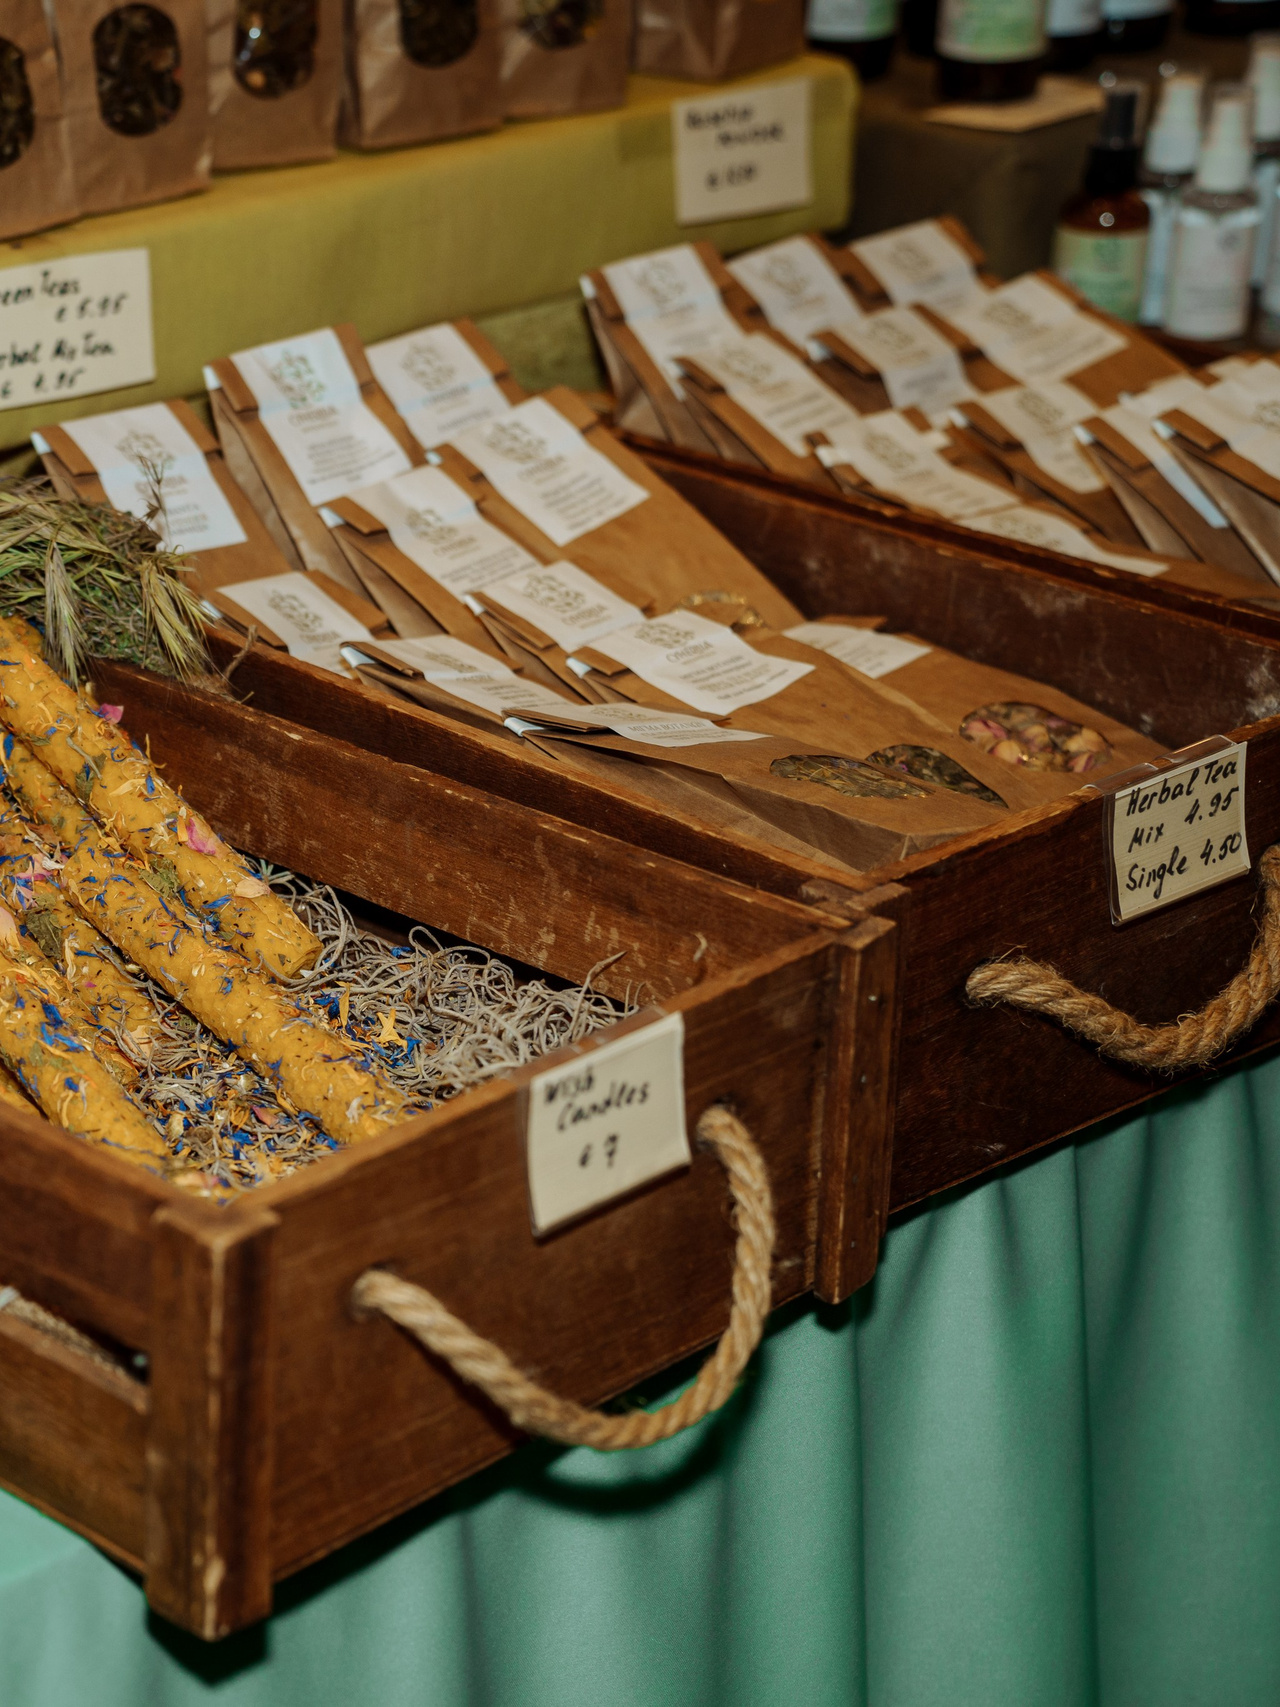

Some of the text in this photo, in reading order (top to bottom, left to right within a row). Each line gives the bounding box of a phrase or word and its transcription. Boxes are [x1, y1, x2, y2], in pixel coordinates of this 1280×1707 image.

[1126, 760, 1237, 817] Herbal Tea
[1184, 786, 1239, 825] 4.95
[1128, 823, 1164, 853] Mix
[1126, 831, 1242, 900] Single 4.50
[558, 1080, 651, 1132] Candles
